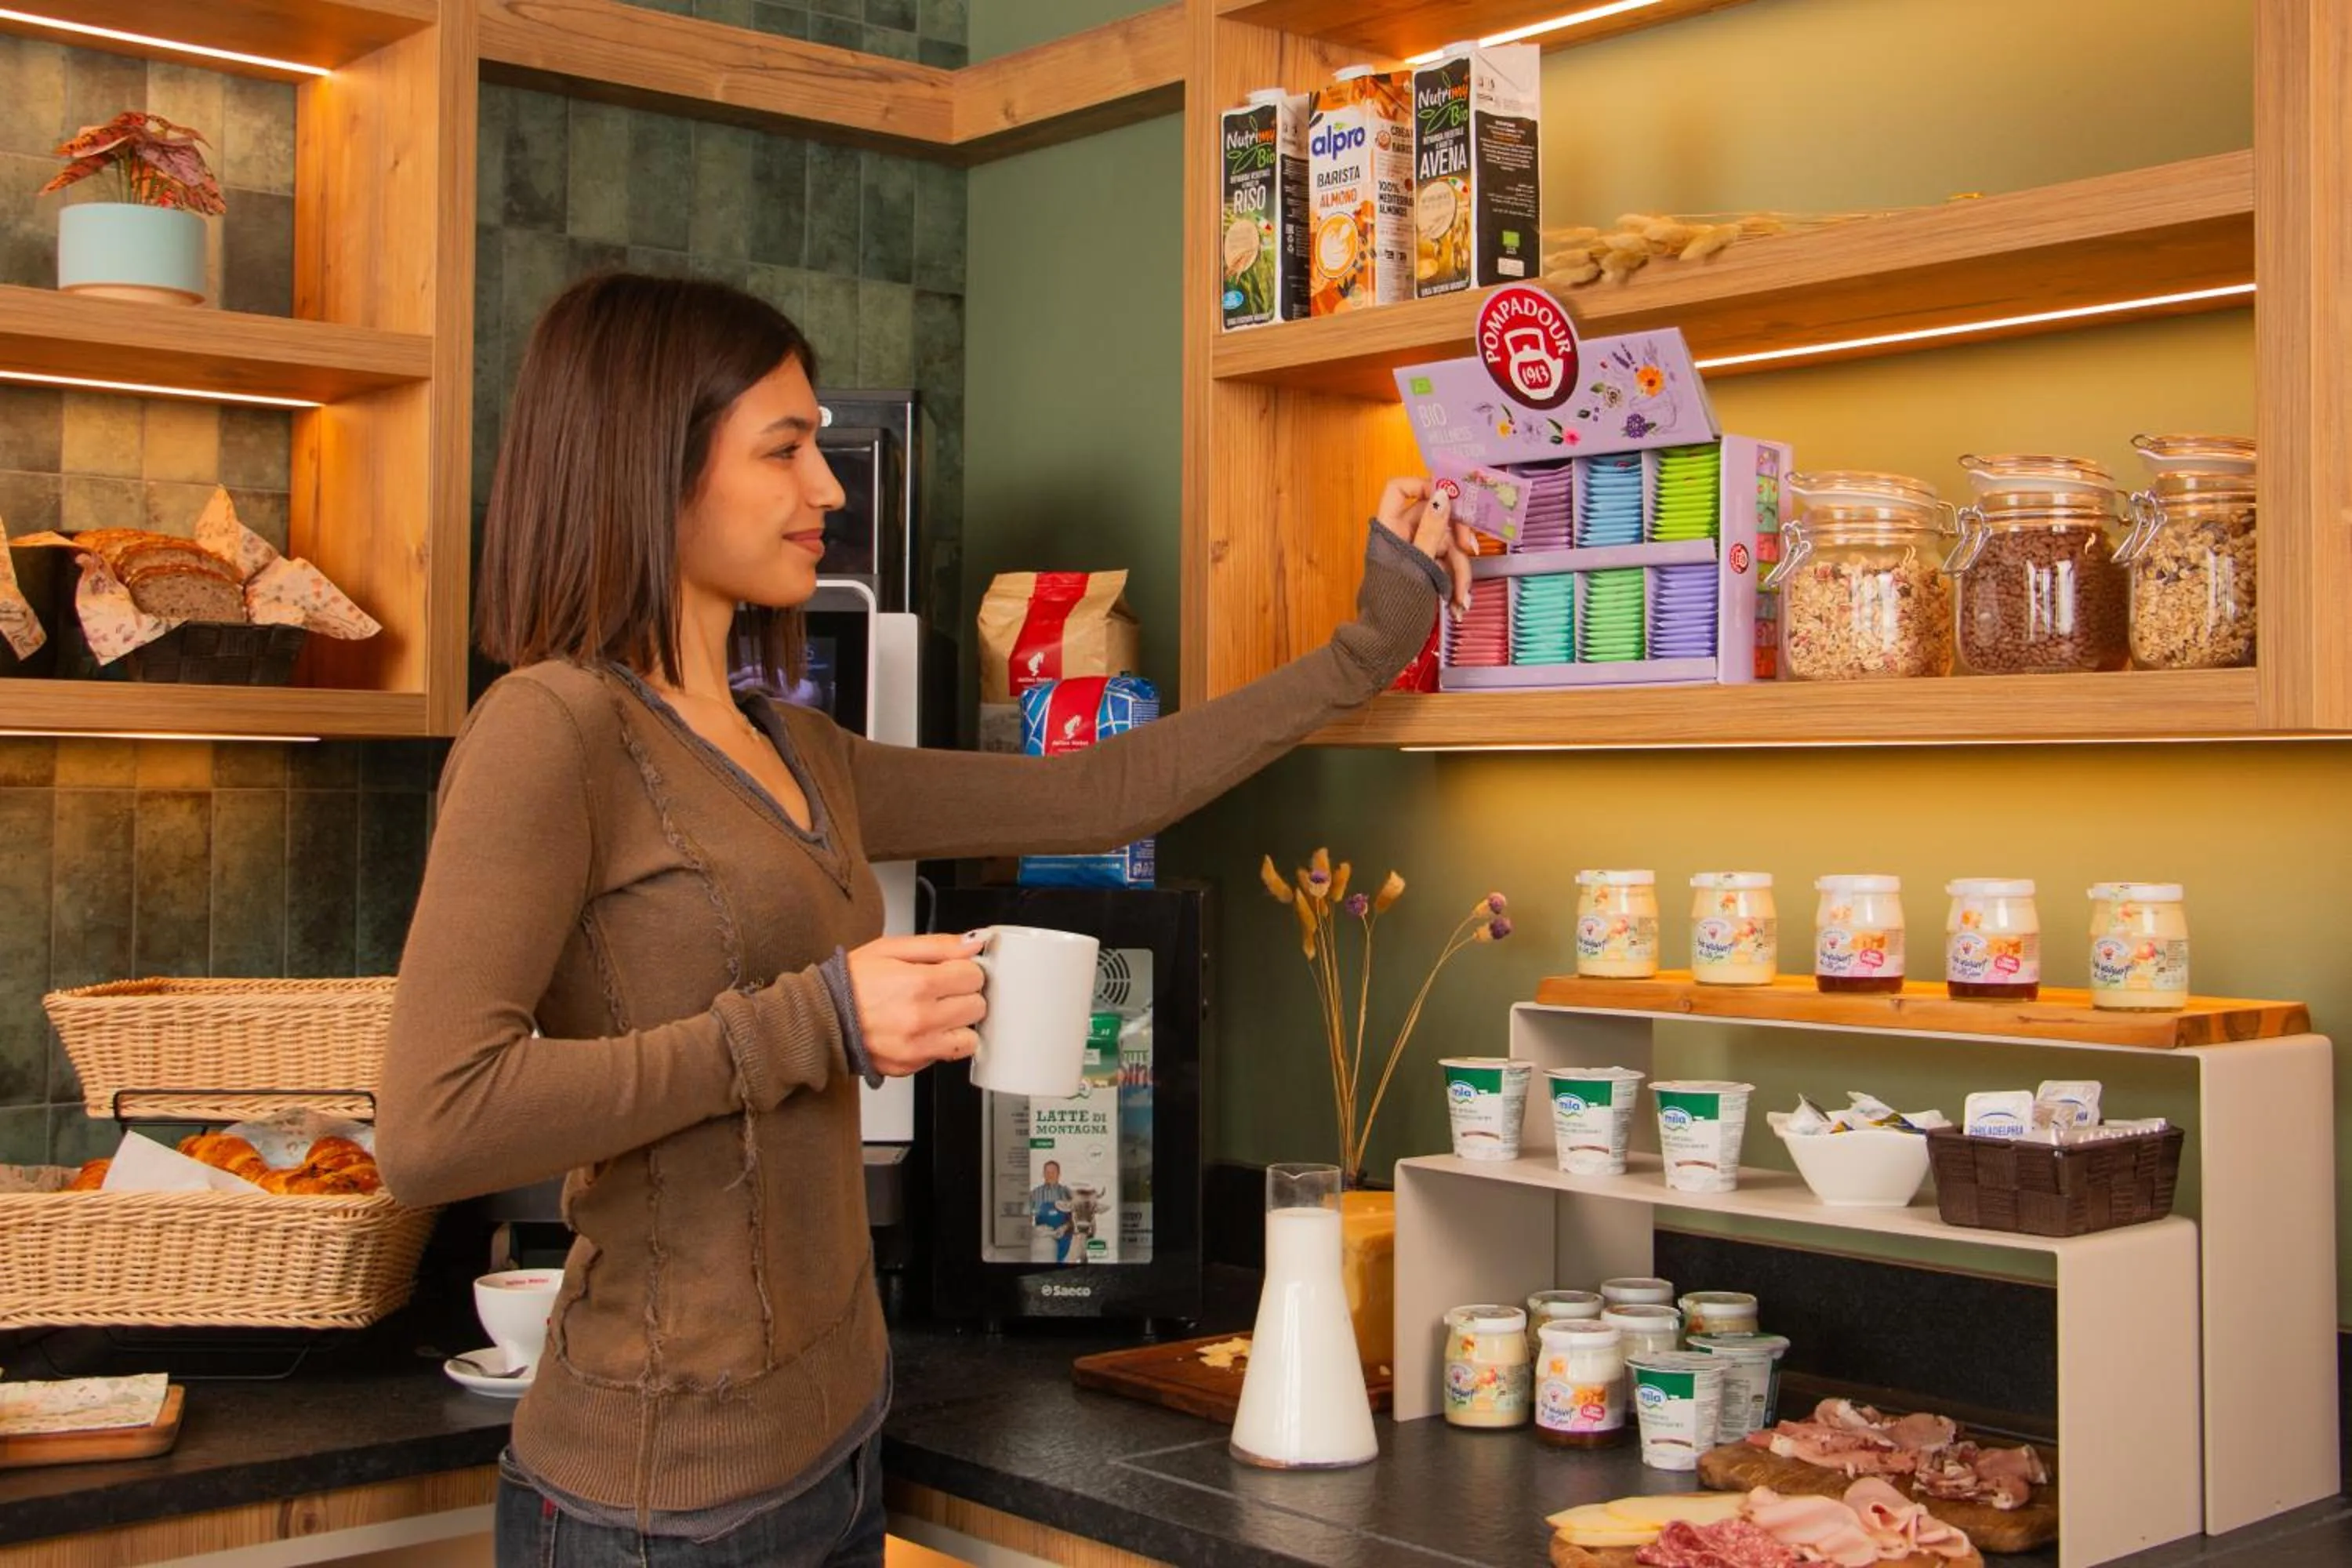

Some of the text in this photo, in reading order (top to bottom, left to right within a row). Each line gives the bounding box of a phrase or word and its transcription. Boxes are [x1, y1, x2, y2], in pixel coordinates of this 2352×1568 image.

[1450, 103, 1468, 126] Bio
[1312, 125, 1365, 160] alpro
[1258, 148, 1276, 168] Bio
[1420, 143, 1467, 180] AVENA
[1317, 165, 1360, 188] BARISTA
[1234, 185, 1266, 214] RISO
[1320, 188, 1356, 208] ALMOND
[1483, 297, 1571, 363] POMPADOUR
[1523, 365, 1549, 385] 1913
[1417, 402, 1447, 427] BIO
[1036, 1110, 1107, 1122] LATTE DI
[1036, 1125, 1108, 1134] MONTAGNA
[1054, 1285, 1091, 1297] Saeco
